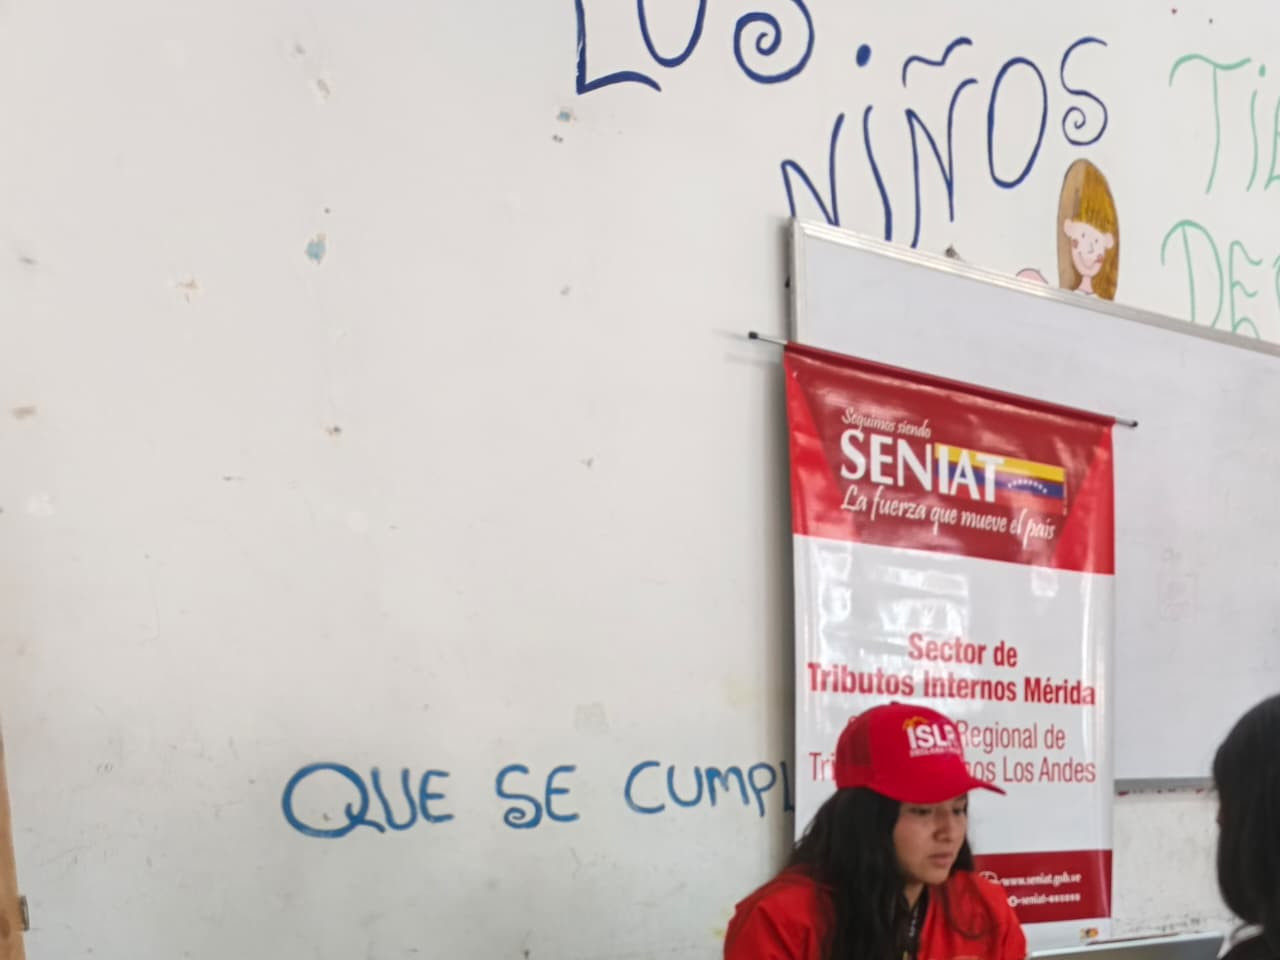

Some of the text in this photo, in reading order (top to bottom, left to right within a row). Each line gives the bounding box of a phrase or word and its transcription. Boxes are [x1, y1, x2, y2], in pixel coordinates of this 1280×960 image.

[840, 427, 1006, 504] SENIAT
[840, 484, 868, 512] La
[870, 484, 926, 521] fuerza
[930, 504, 958, 536] que
[960, 510, 1007, 534] mueve
[1009, 508, 1028, 536] el
[907, 632, 1018, 668] Sector de
[806, 661, 1097, 706] Tributos Internos Mérida
[955, 719, 1066, 755] Regional de
[1003, 755, 1035, 783] Los
[1037, 756, 1097, 784] Andes
[281, 761, 455, 839] QUE
[495, 764, 580, 829] SE
